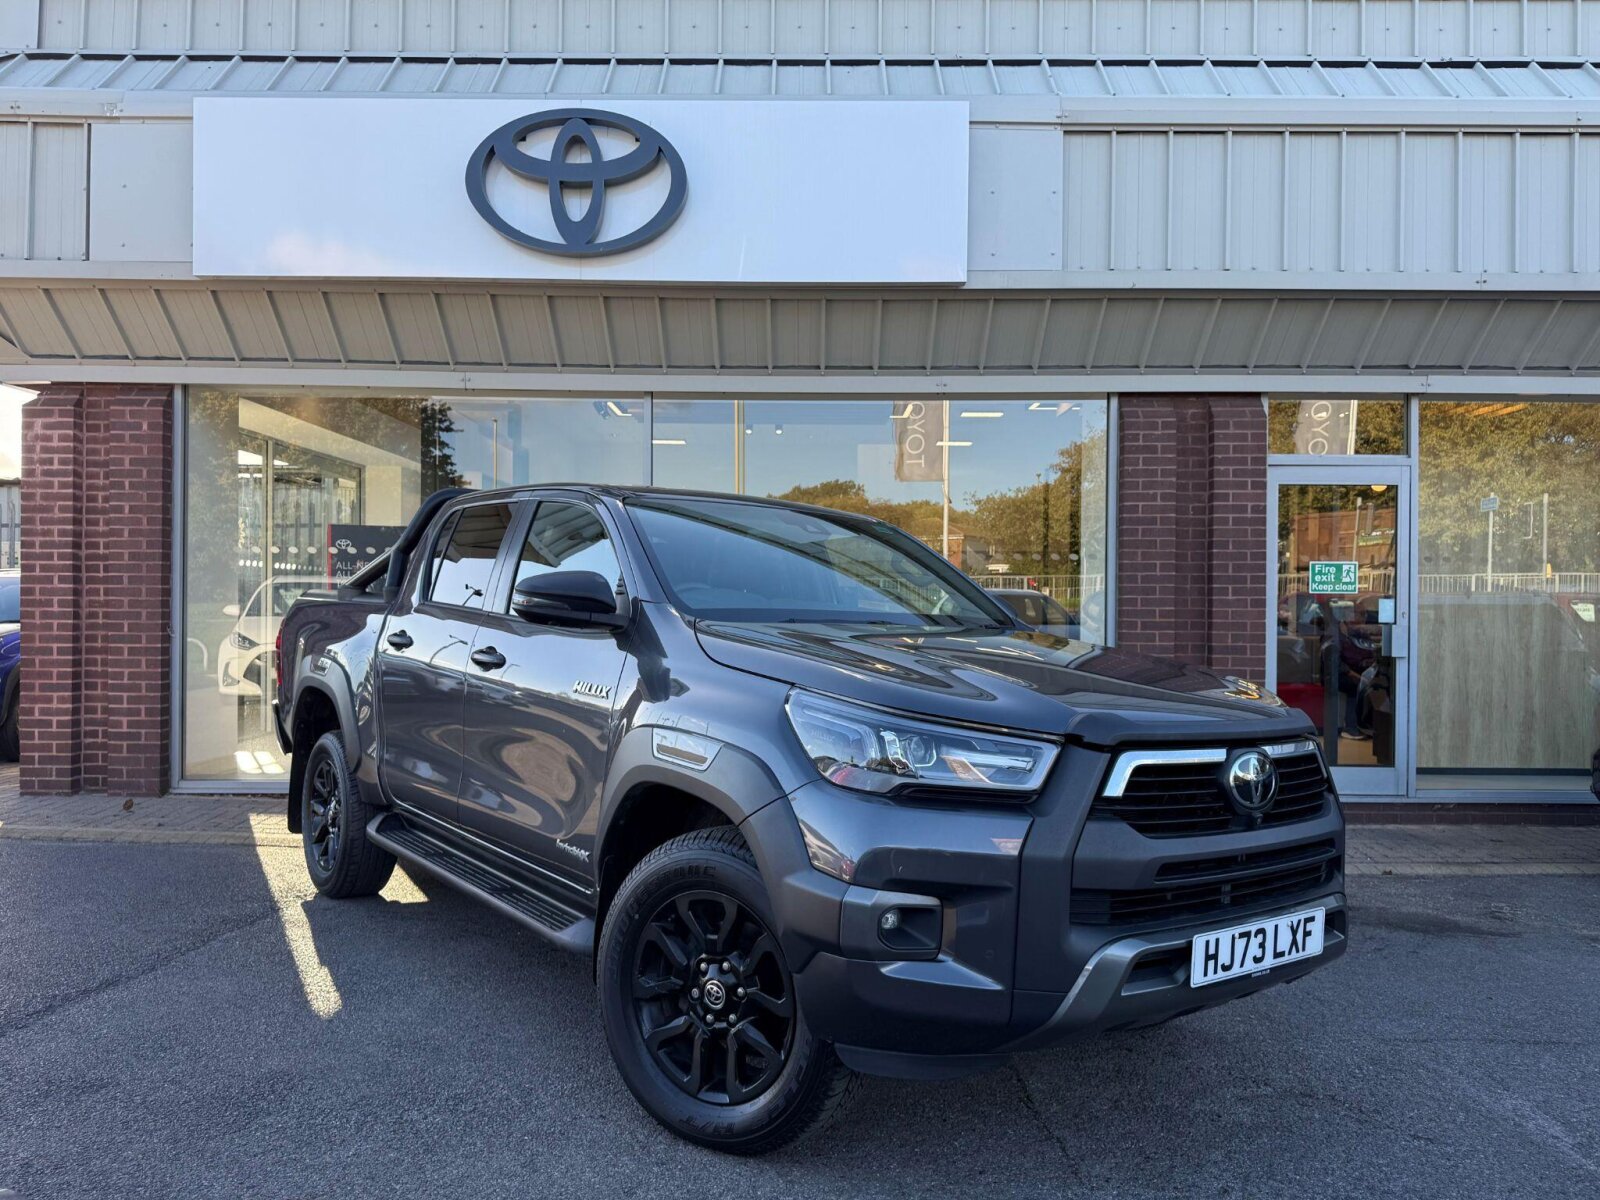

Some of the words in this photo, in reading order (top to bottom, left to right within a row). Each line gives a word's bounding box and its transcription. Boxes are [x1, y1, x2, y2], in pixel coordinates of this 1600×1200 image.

[1315, 564, 1336, 573] Fire
[1315, 573, 1335, 582] exit
[1312, 583, 1334, 592] Keep
[1335, 583, 1355, 591] clear
[573, 680, 612, 700] HILUX
[1203, 927, 1267, 977] HJ73
[1272, 915, 1316, 960] LXF
